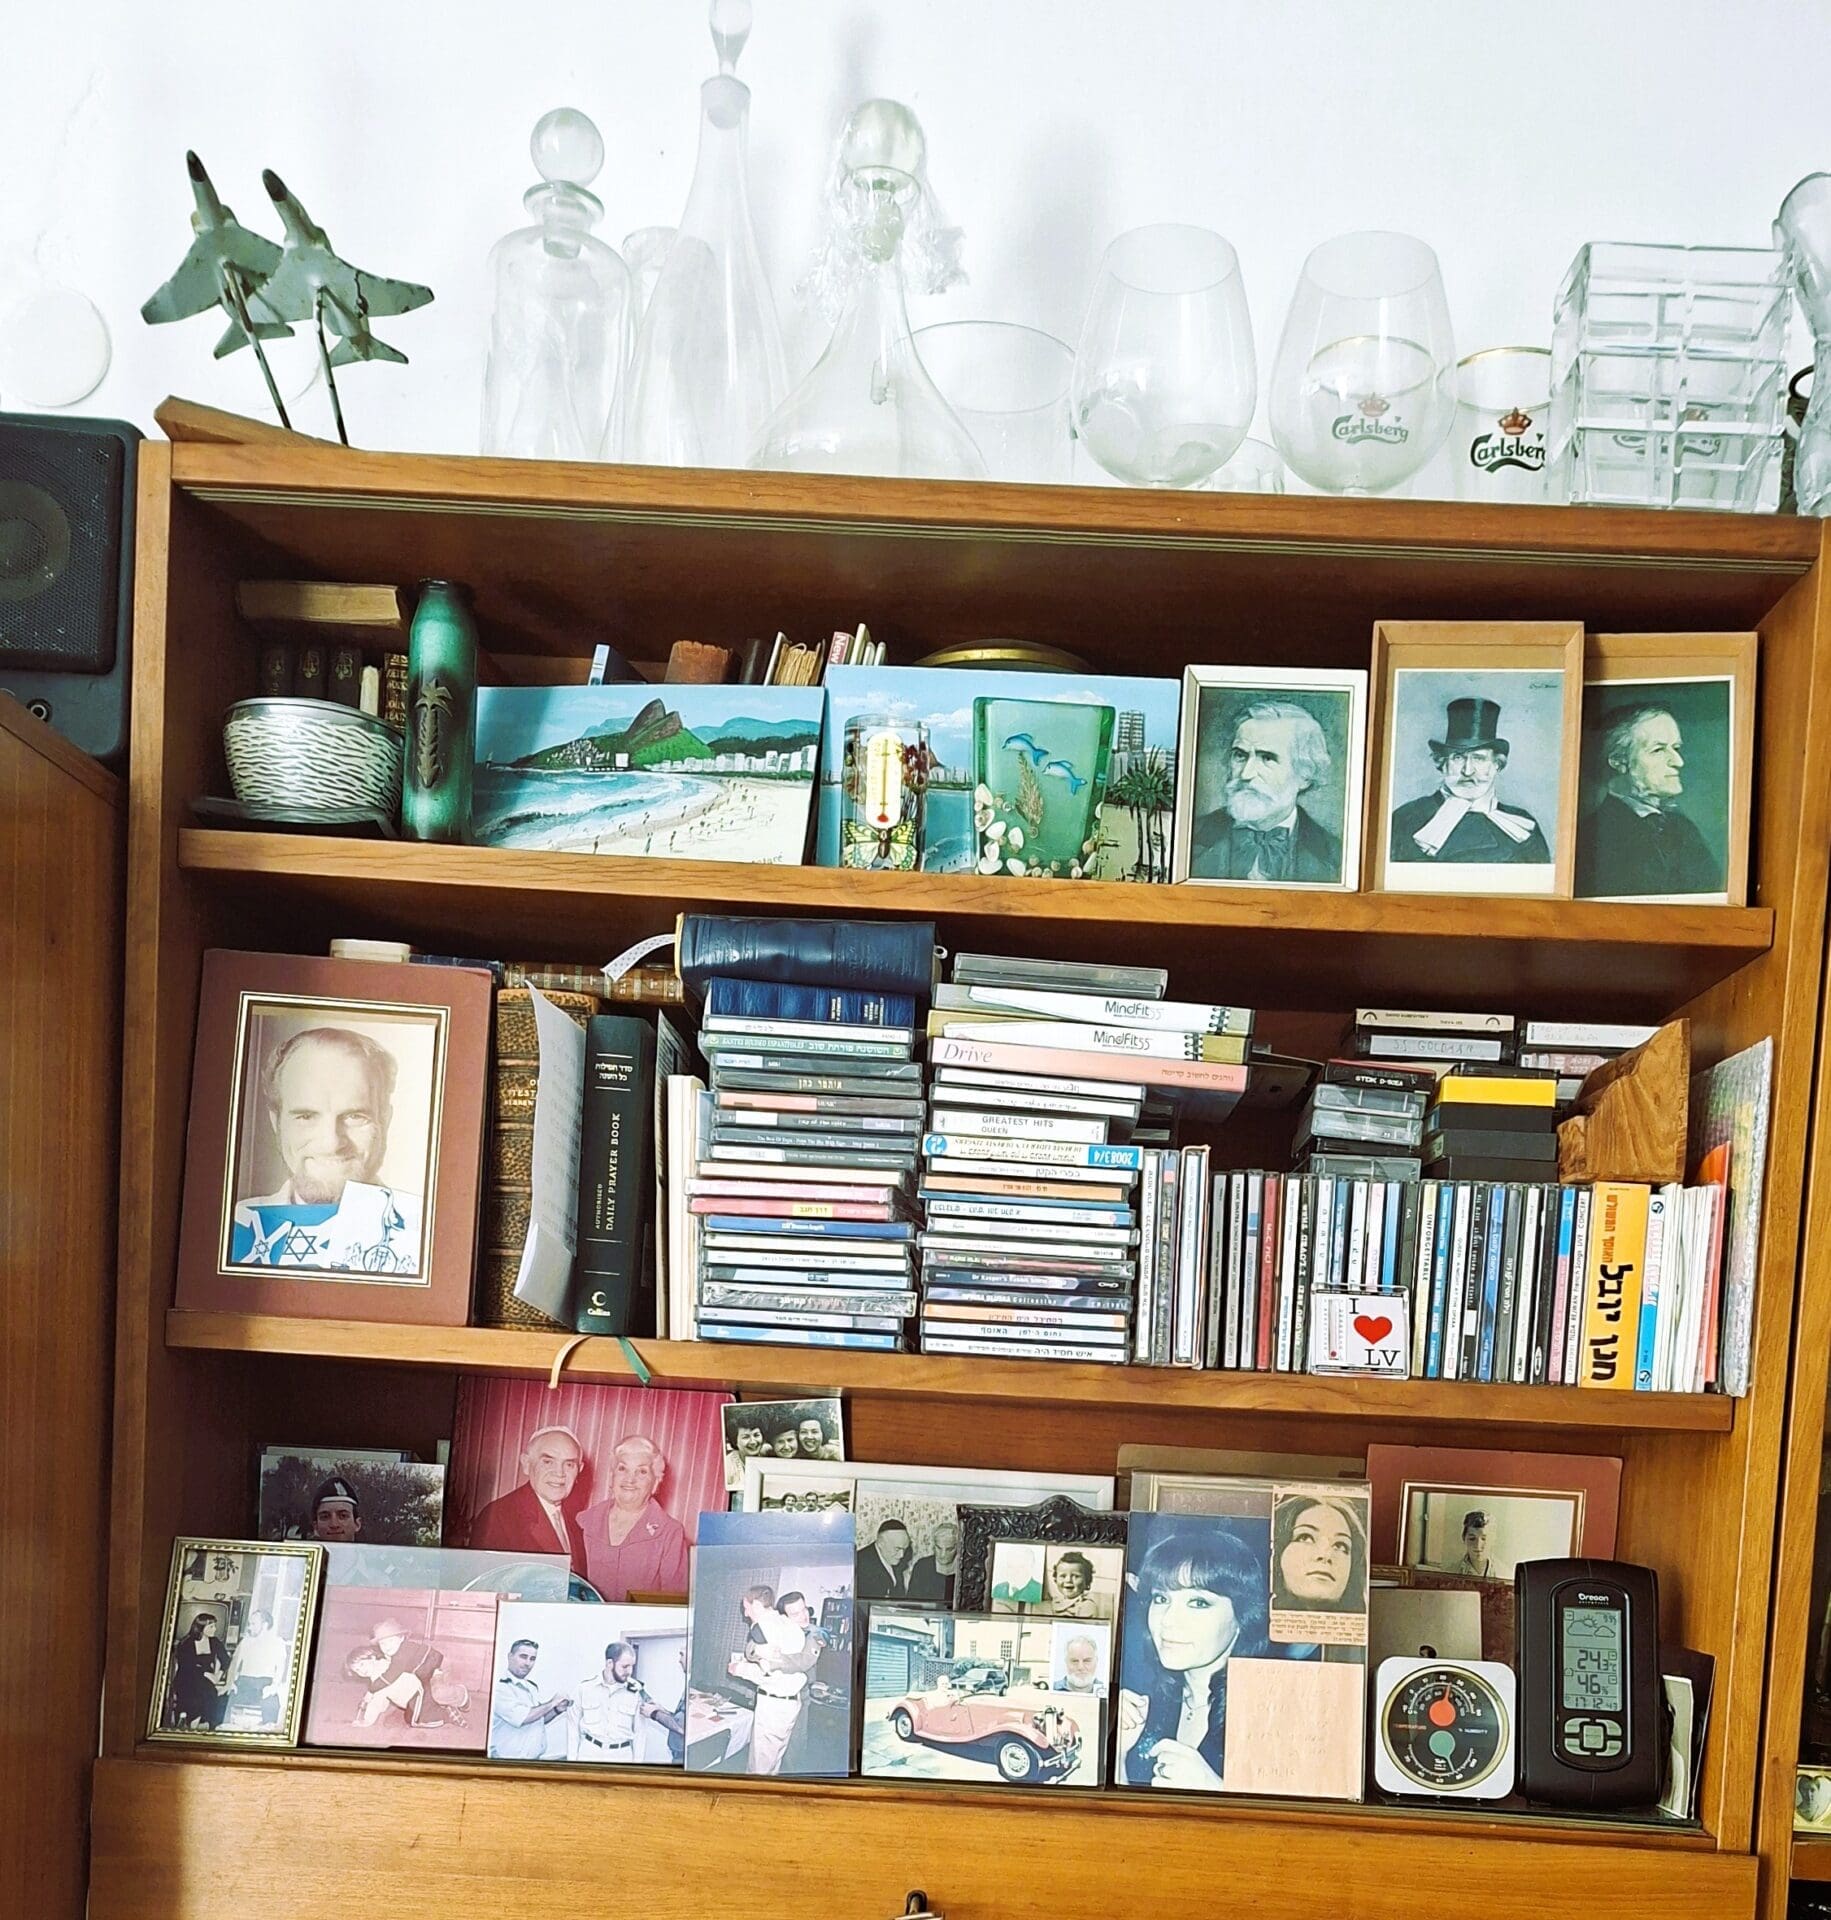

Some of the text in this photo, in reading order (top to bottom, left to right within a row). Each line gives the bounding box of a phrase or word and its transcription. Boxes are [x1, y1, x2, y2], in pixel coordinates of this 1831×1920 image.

[1332, 415, 1409, 445] Carlsberg
[831, 632, 847, 664] New
[944, 1043, 993, 1063] Drive
[618, 1064, 633, 1074] סדר
[618, 1073, 628, 1082] כל
[981, 1126, 1008, 1135] QUEEN
[982, 1115, 1054, 1128] GREATEST HITS
[605, 1113, 620, 1231] DAILY PRAYER BOOK
[595, 1183, 603, 1230] AUTHORISED
[1577, 1197, 1586, 1229] CONCERT
[1602, 1194, 1618, 1264] האוסף המשולש
[1422, 1214, 1433, 1281] UNFORGETTABLE
[1576, 1234, 1584, 1247] LIVE
[1299, 1234, 1308, 1267] LOVED
[1489, 1233, 1499, 1281] belly dance
[1348, 1297, 1360, 1315] I
[980, 1327, 1008, 1336] האוסף
[1589, 1264, 1634, 1381] חנן יובל
[1043, 1330, 1063, 1338] נחום
[1033, 1348, 1050, 1356] היה
[1052, 1349, 1073, 1357] חסיד
[1364, 1349, 1400, 1368] LV
